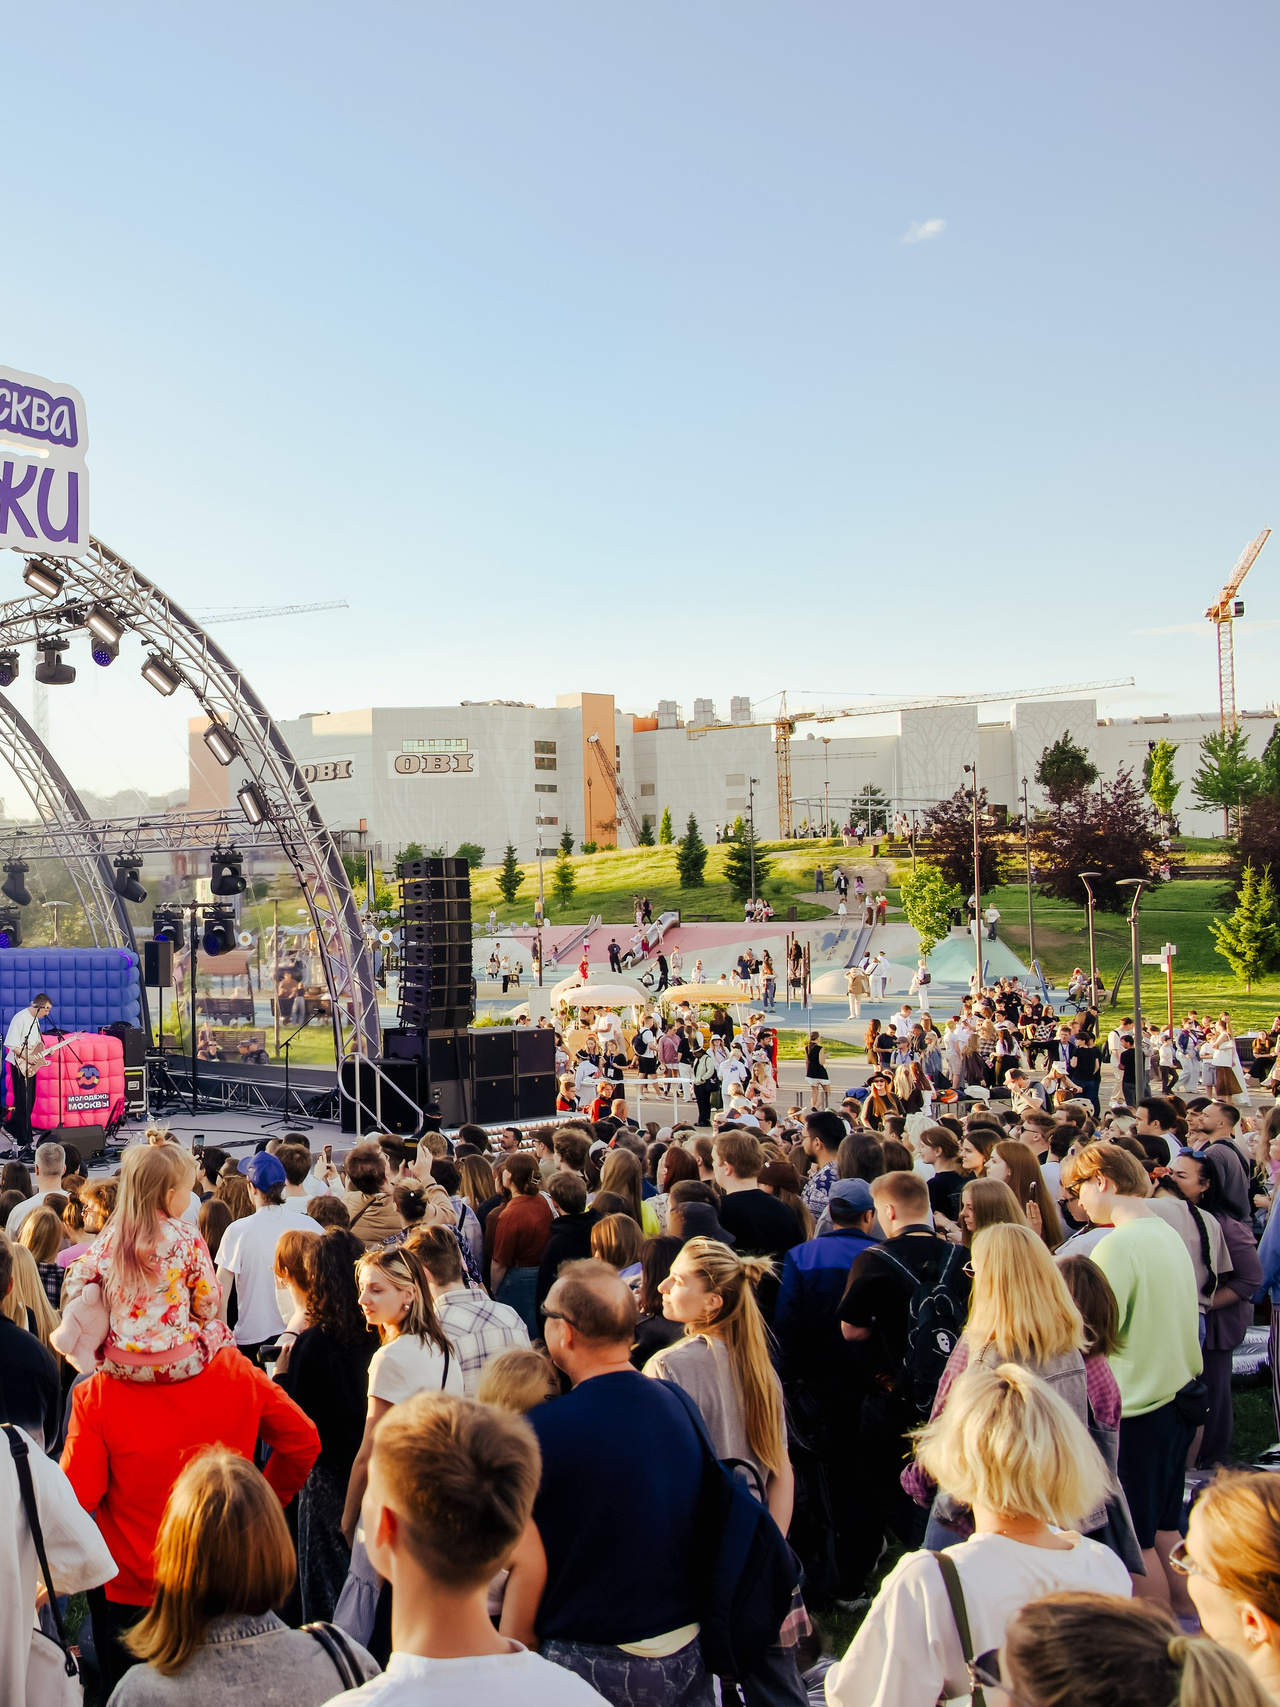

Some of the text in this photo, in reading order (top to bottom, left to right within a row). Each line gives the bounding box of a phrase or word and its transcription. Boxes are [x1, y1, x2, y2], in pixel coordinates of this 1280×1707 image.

[300, 760, 352, 783] OBI
[395, 754, 474, 774] OBI
[68, 1100, 109, 1111] МОСКВЫ
